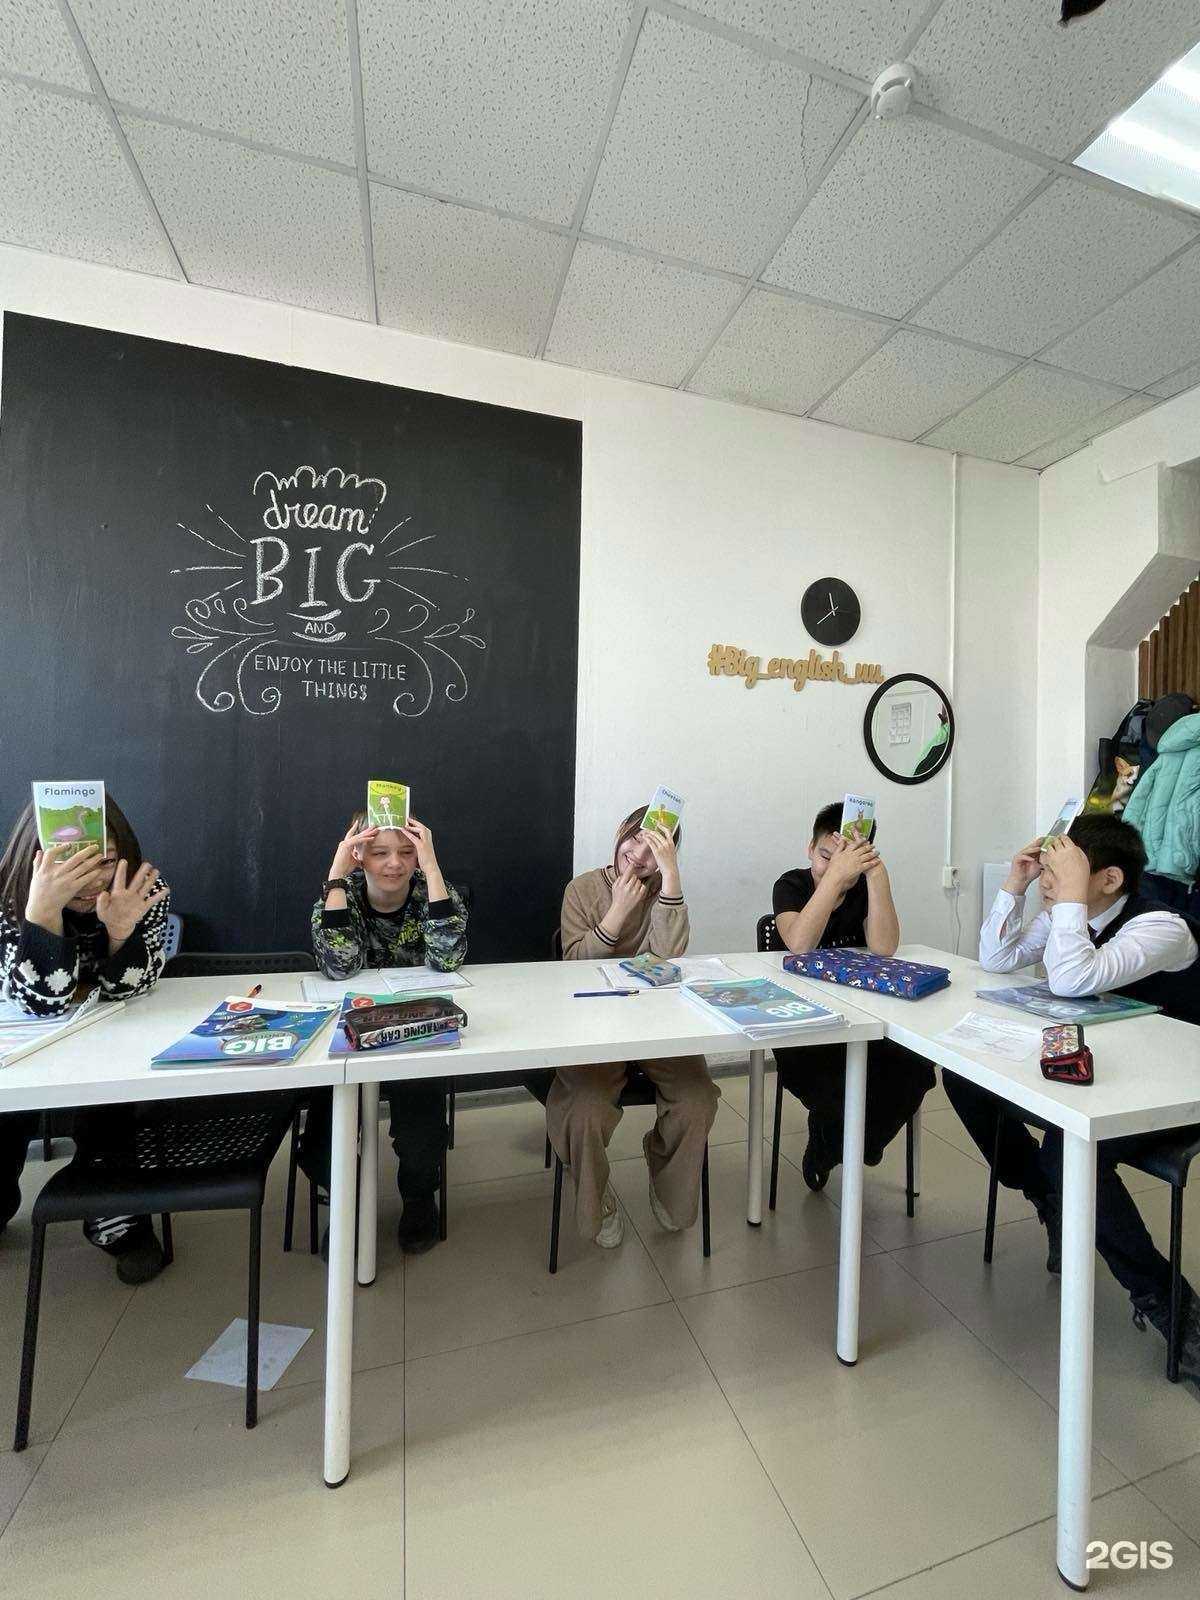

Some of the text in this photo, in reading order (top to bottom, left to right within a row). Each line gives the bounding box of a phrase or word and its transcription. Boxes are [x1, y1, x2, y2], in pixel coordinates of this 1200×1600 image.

[263, 489, 369, 534] dream
[250, 536, 381, 608] BIG
[304, 621, 336, 635] AND
[254, 655, 407, 681] ENJOY THE LITTLE
[301, 680, 368, 701] THINGS
[44, 788, 96, 798] Flamingo
[766, 1001, 815, 1018] BIG
[380, 1020, 440, 1042] RACING CAR
[224, 1036, 292, 1055] BIG
